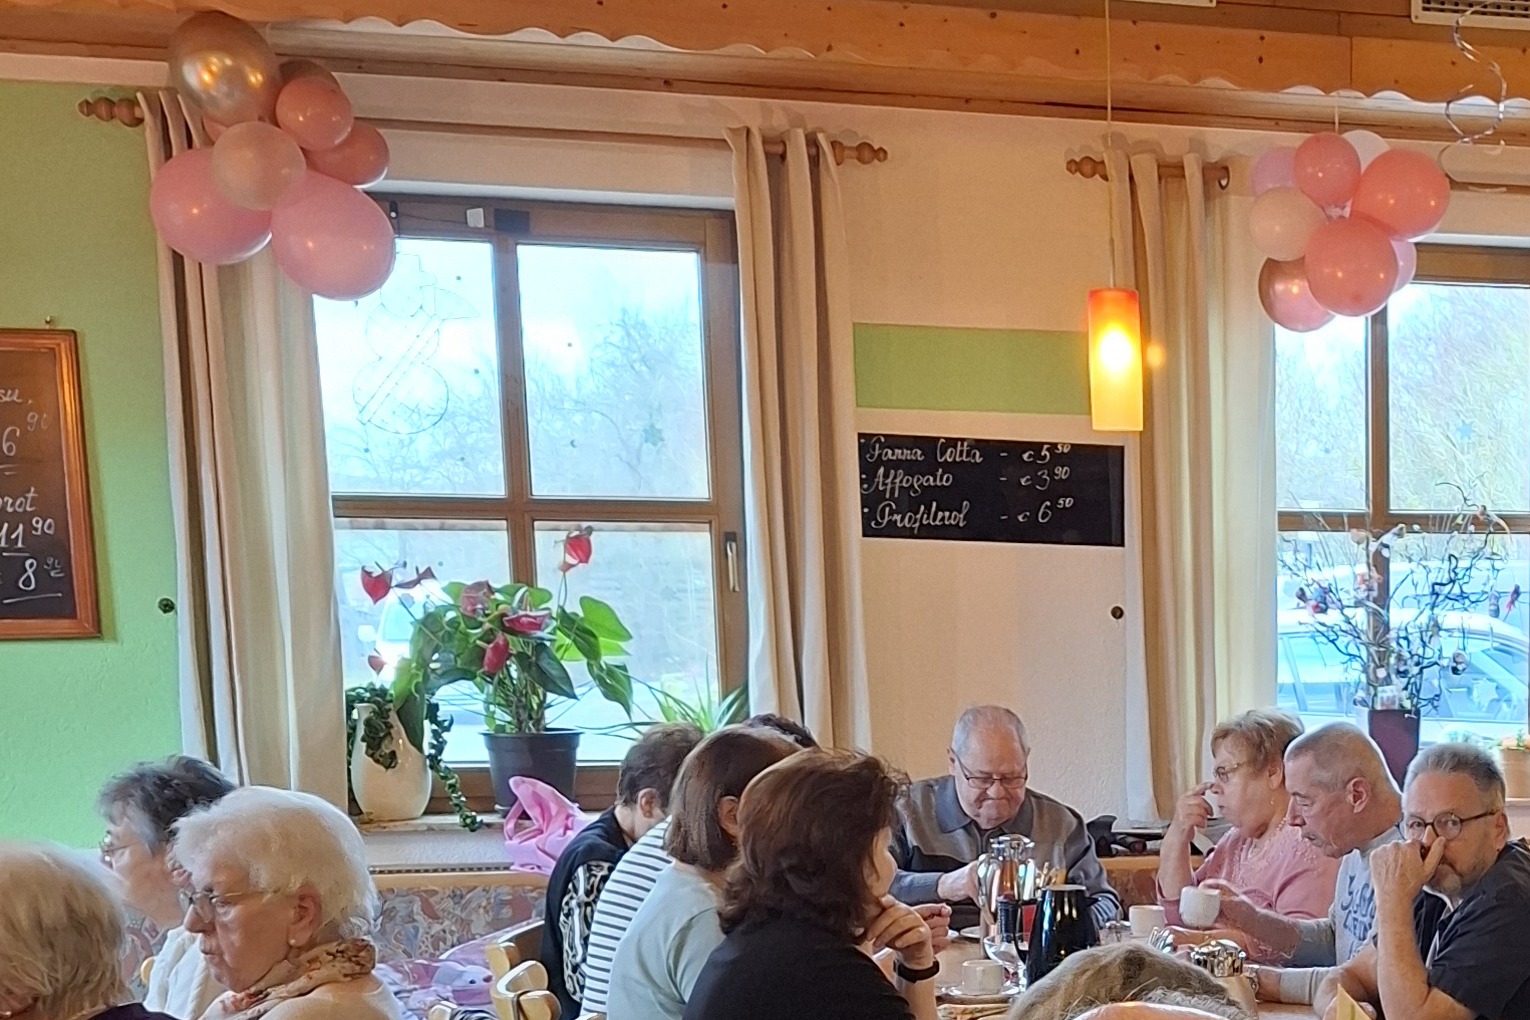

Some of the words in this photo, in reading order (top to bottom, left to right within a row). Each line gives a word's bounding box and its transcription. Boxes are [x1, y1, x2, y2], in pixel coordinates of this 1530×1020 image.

[866, 436, 924, 462] Panna
[936, 438, 984, 463] Cotta
[861, 465, 953, 498] Affogato
[0, 486, 38, 512] rot
